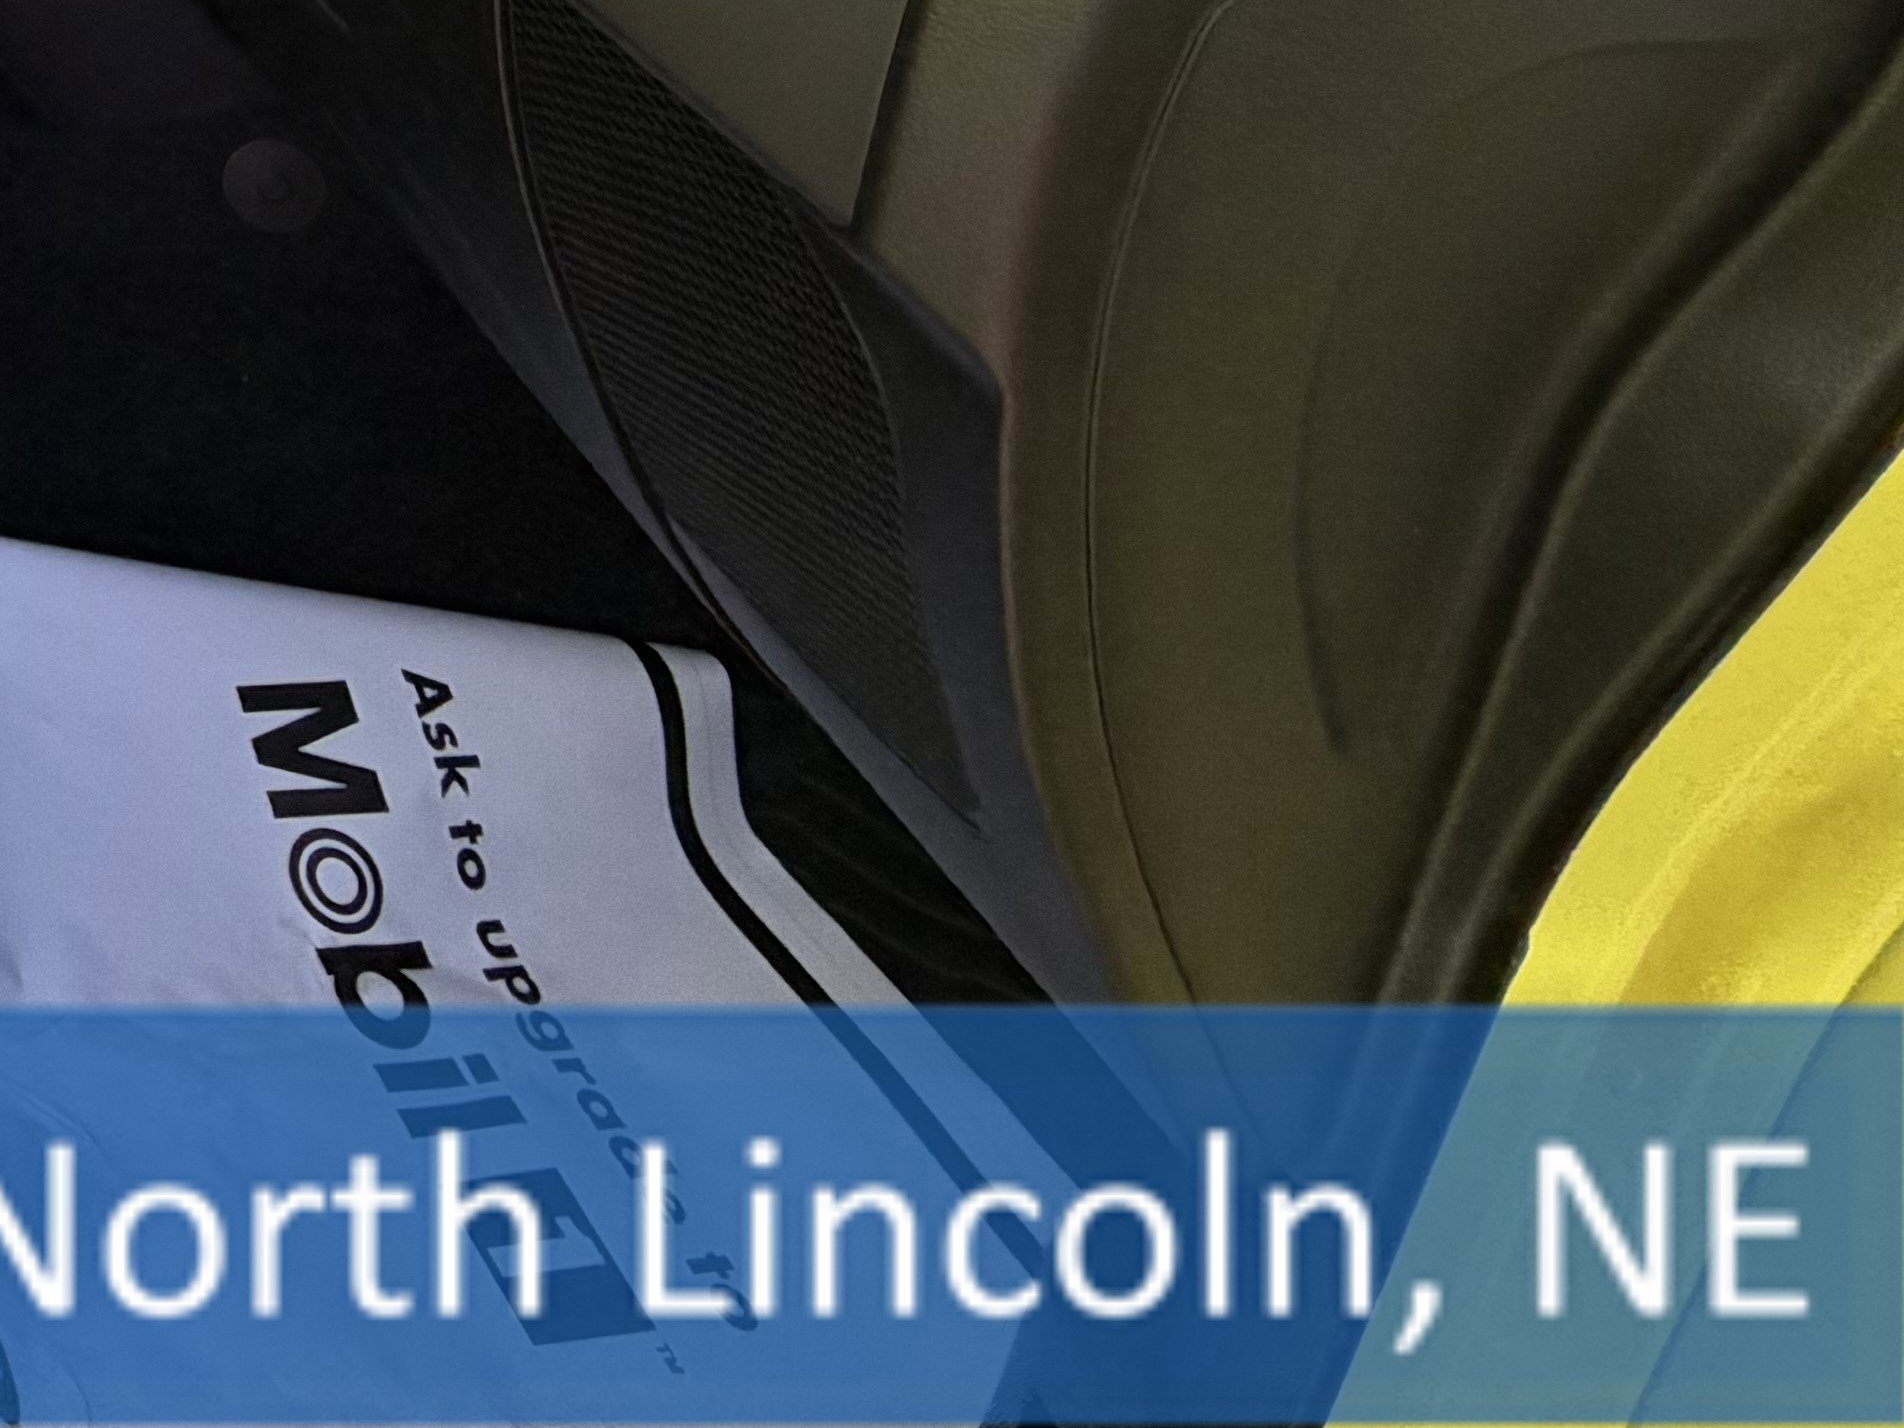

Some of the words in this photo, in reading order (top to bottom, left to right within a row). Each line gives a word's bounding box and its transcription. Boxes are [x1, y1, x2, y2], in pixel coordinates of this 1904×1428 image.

[235, 680, 528, 1140] Mobil
[400, 667, 482, 799] Ask
[448, 819, 487, 891] to
